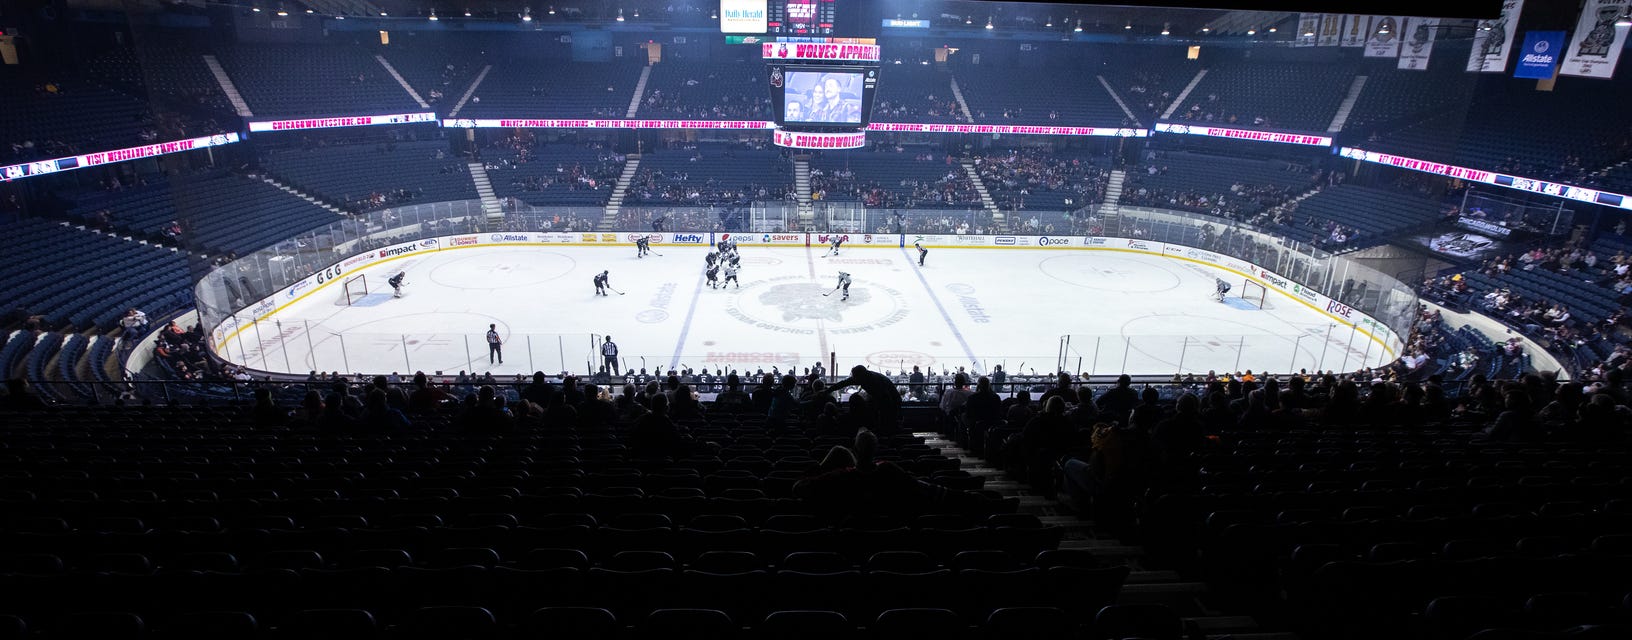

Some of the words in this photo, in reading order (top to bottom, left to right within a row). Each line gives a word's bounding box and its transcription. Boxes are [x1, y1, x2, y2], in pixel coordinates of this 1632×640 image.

[725, 10, 741, 19] Daily
[743, 10, 763, 19] Herald
[796, 44, 838, 59] WOLVES
[839, 45, 874, 60] APPAREL
[1522, 53, 1553, 64] Allstate
[272, 117, 372, 130] CHICAGOWOLVESSTORE.COM
[611, 120, 621, 128] THE
[623, 120, 640, 128] THREE
[1051, 127, 1074, 135] STANDS
[1208, 128, 1224, 136] VISIT
[1225, 129, 1272, 140] MERCHANDISE
[1273, 134, 1300, 143] STANDS
[1301, 136, 1322, 145] NOW!
[86, 153, 105, 166] VISIT
[107, 147, 154, 163] MERCHANDISE
[155, 142, 179, 156] STANDS
[179, 140, 195, 152] NOW!
[1464, 168, 1489, 181] TODAY!
[1458, 216, 1485, 228] CHICAGO
[1485, 223, 1512, 236] WOLVES
[674, 234, 702, 243] Hefty
[733, 235, 754, 243] pepsi
[386, 244, 417, 257] impact
[317, 272, 324, 284] G
[326, 268, 333, 280] G
[335, 264, 341, 275] G
[1265, 271, 1288, 289] impact
[1301, 287, 1316, 298] Flood
[1326, 299, 1353, 318] ROSE
